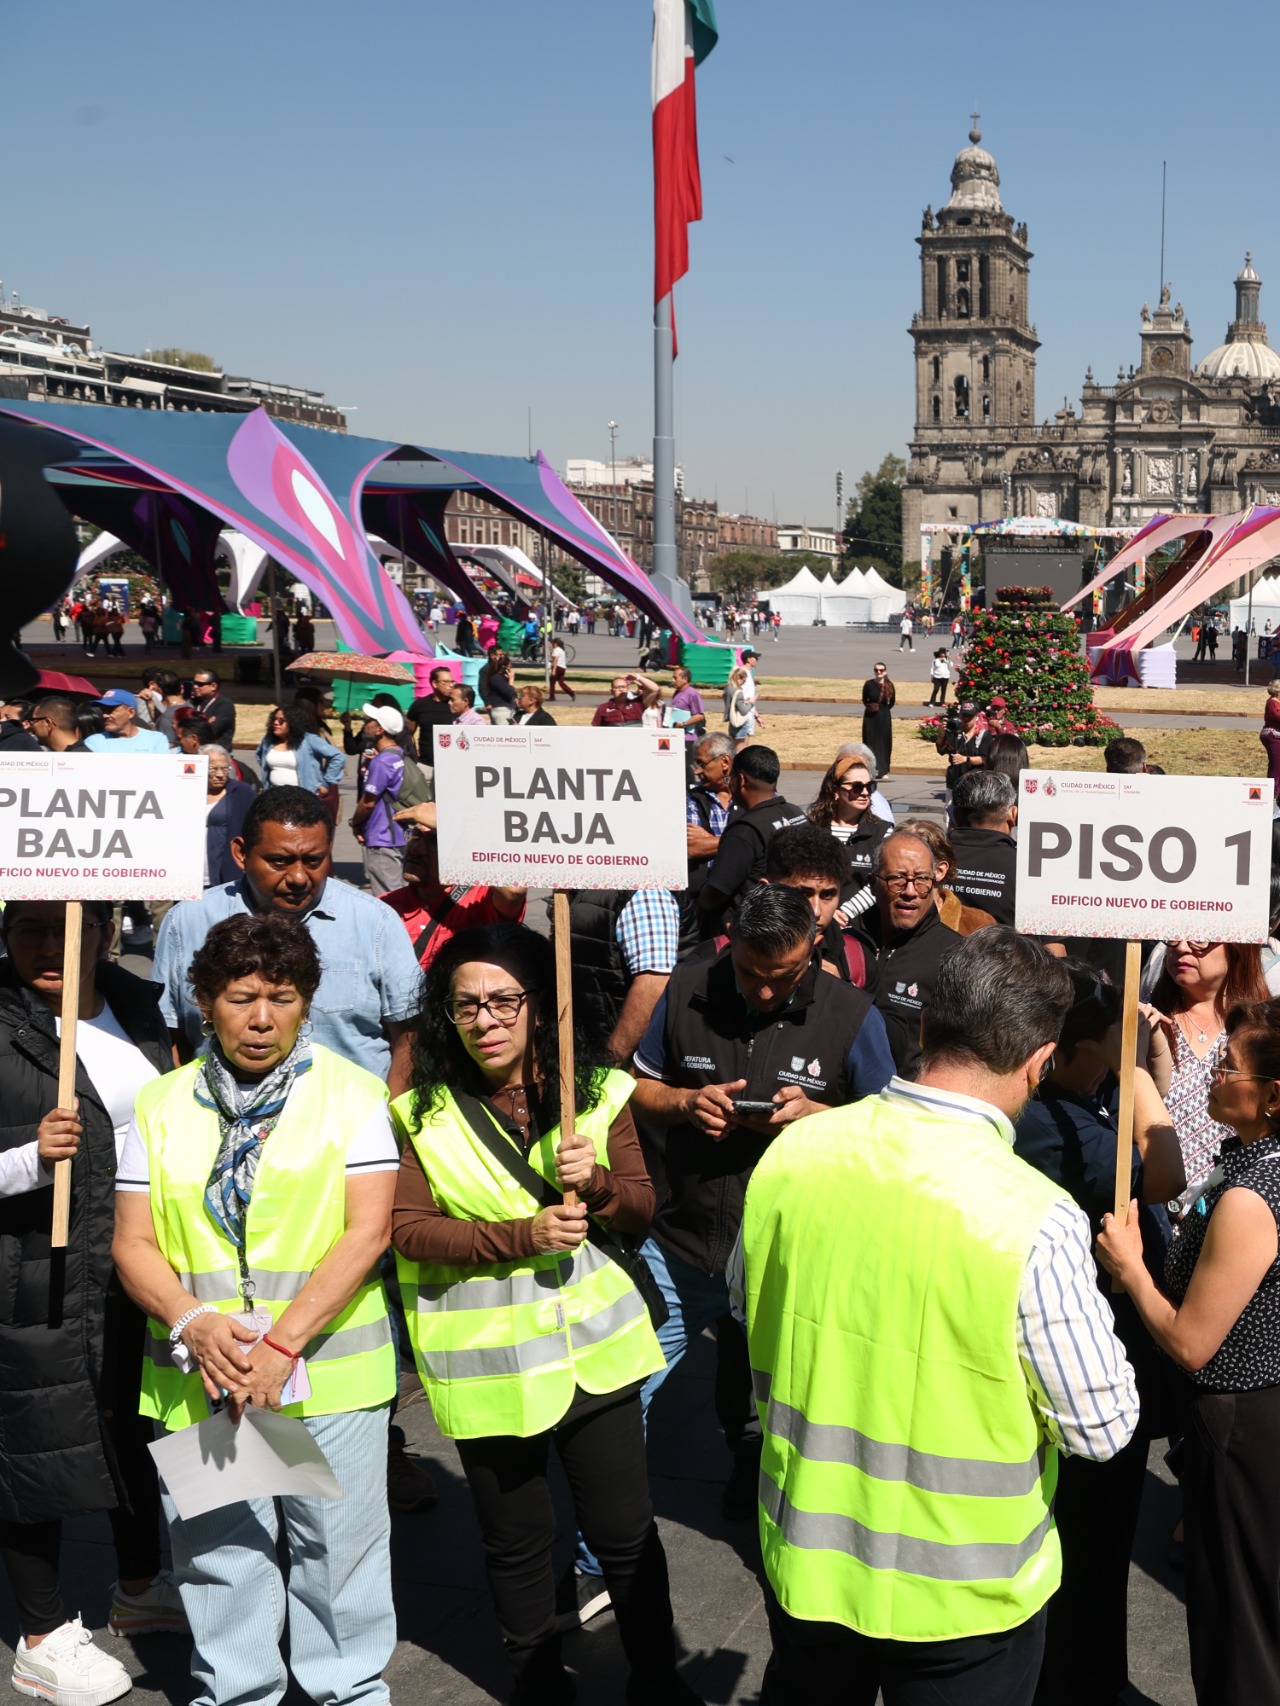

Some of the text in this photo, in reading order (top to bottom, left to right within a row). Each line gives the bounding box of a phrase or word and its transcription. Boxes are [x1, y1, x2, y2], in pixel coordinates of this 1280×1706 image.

[475, 766, 642, 802] PLANTA
[1093, 782, 1116, 790] MÉXICO
[0, 788, 164, 820] PLANTA
[504, 810, 615, 845] BAJA
[17, 828, 133, 859] BAJA
[472, 852, 649, 866] EDIFICIO NUEVO DE GOBIERNO
[1028, 821, 1252, 886] PISO 1
[35, 867, 79, 877] NUEVO
[83, 868, 99, 877] DE
[102, 868, 167, 878] GOBIERNO
[984, 871, 1006, 880] MÉXICO
[955, 885, 965, 893] DE
[965, 887, 1002, 898] GOBIERNO
[1051, 895, 1234, 912] EDIFICIO NUEVO DE GOBIERNO
[683, 1055, 711, 1064] JEFATURA
[686, 1062, 716, 1071] GOBIERNO
[778, 1070, 799, 1080] CIUDAD
[806, 1077, 827, 1087] MÉXICO
